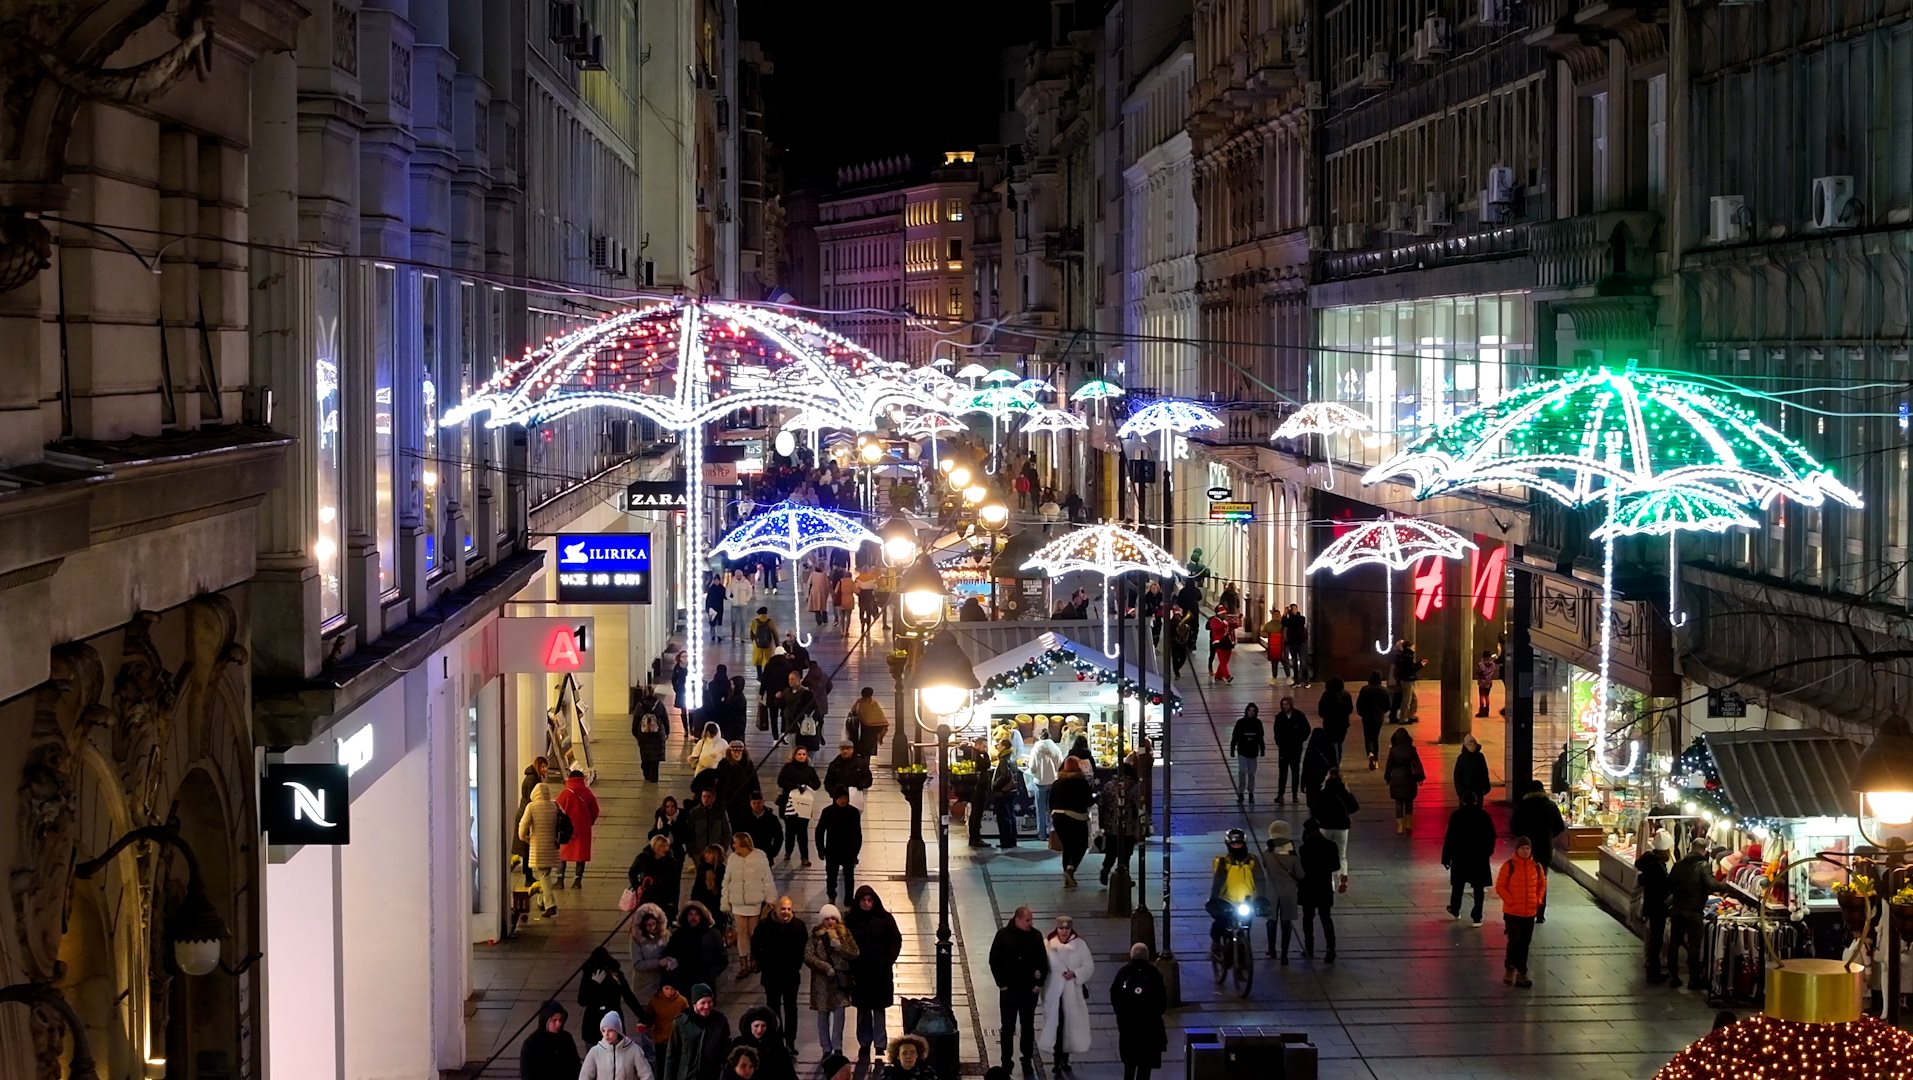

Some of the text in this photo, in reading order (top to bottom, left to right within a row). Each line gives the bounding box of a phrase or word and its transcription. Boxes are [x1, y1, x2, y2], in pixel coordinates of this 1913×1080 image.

[631, 494, 687, 505] ZARA
[589, 549, 647, 560] ILIRIKA
[546, 625, 586, 665] A1
